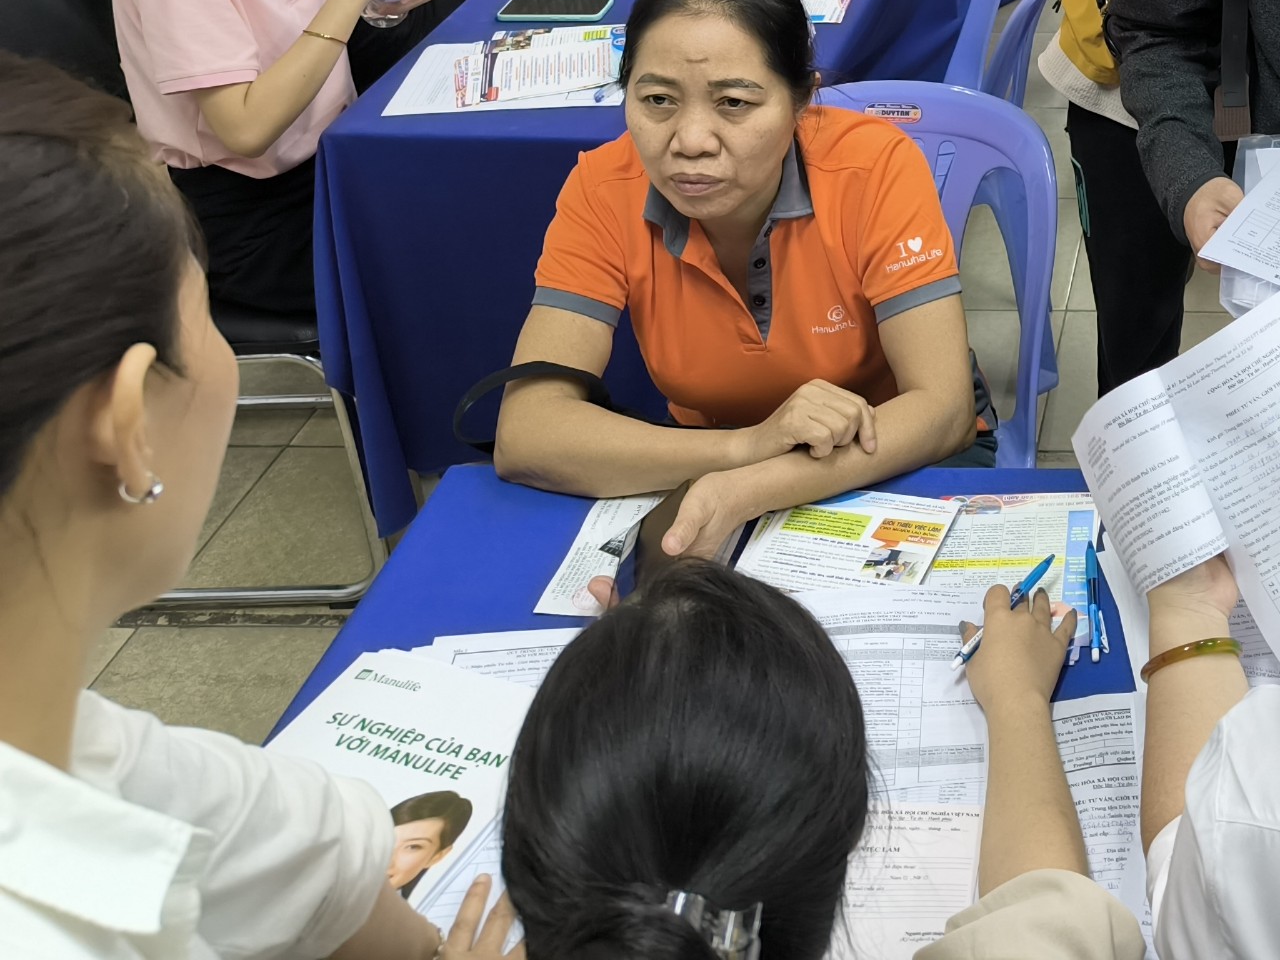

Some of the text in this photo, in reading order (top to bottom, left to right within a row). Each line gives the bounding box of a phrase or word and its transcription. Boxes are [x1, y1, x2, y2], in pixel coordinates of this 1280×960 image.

[369, 672, 422, 693] Manulife
[325, 711, 510, 769] SỰ NGHIỆP CỦA BẠN
[334, 733, 468, 781] VỚI MANULIFE
